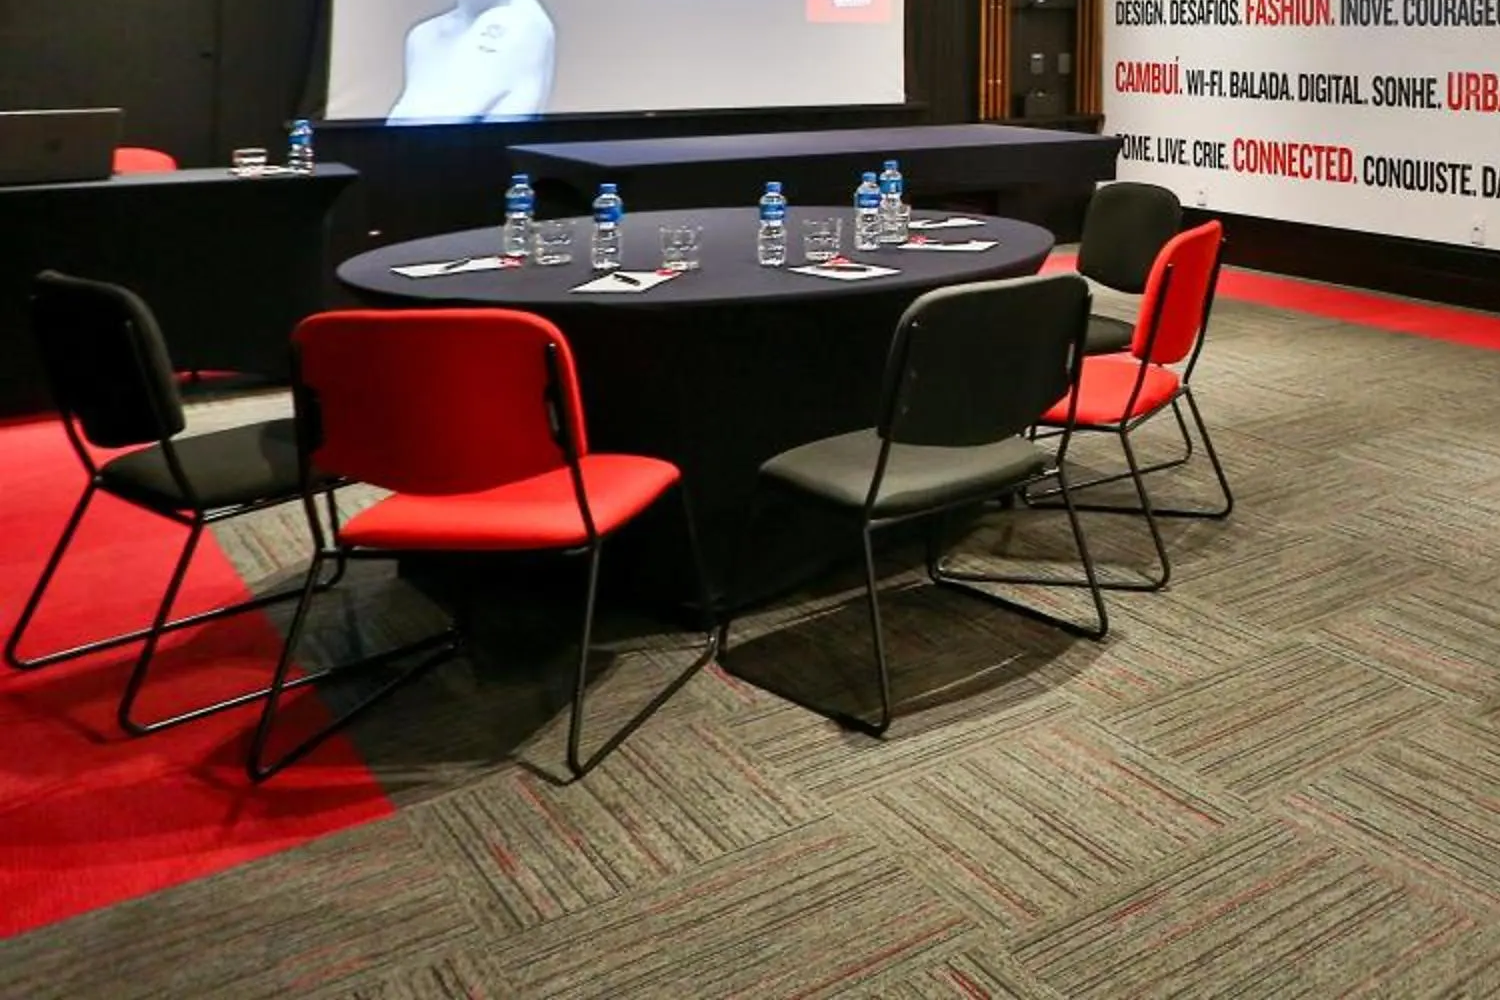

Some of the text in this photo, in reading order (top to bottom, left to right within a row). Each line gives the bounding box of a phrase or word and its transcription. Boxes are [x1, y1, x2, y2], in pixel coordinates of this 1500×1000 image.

[1116, 0, 1166, 26] DESIGN.
[1115, 56, 1182, 95] CAMBUÍ.
[1186, 70, 1226, 96] WI-FI.
[1230, 72, 1294, 100] BALADA.
[1299, 74, 1368, 104] DIGITAL.
[1372, 76, 1441, 109] SONHE.
[1158, 137, 1190, 165] LIVE.
[1194, 140, 1229, 170] CRIE.
[1234, 138, 1356, 182] CONNECTED.
[1364, 156, 1476, 196] CONQUISTE.
